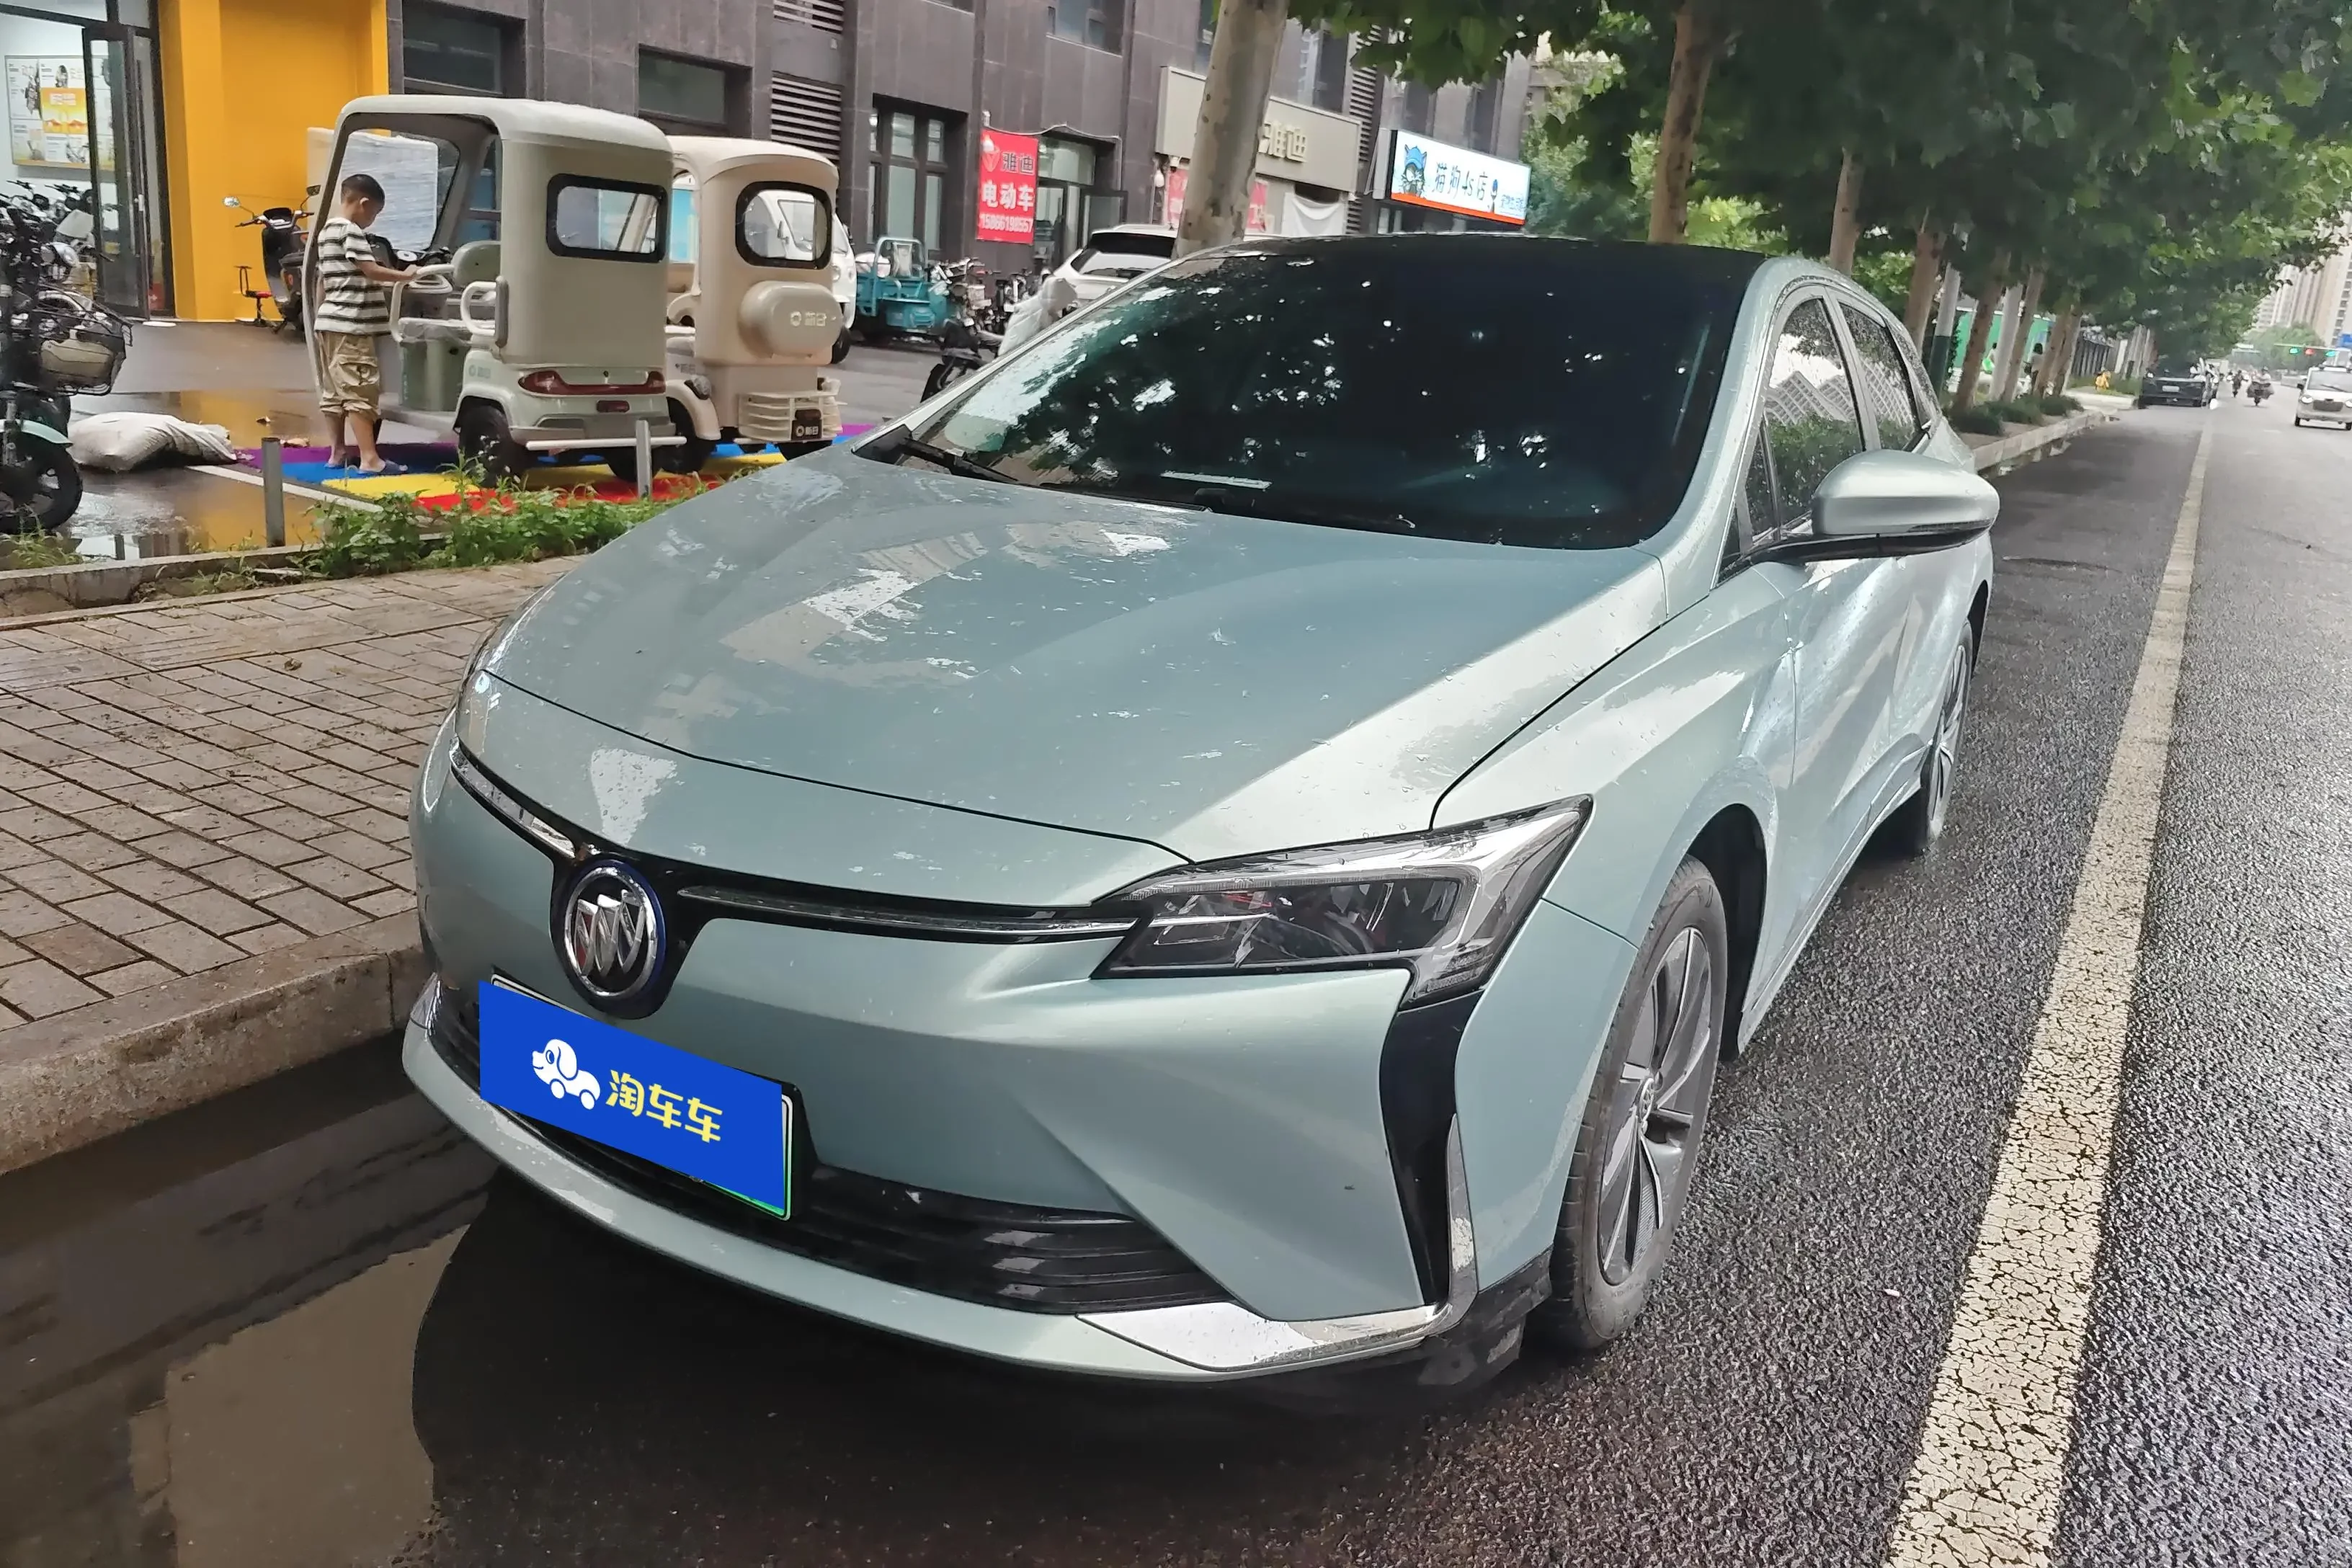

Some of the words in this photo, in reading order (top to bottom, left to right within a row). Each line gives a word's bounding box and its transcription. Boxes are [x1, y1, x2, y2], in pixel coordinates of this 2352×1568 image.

[1257, 120, 1308, 163] 雅迪
[1001, 151, 1035, 175] 雅迪
[981, 179, 1034, 211] 电动车
